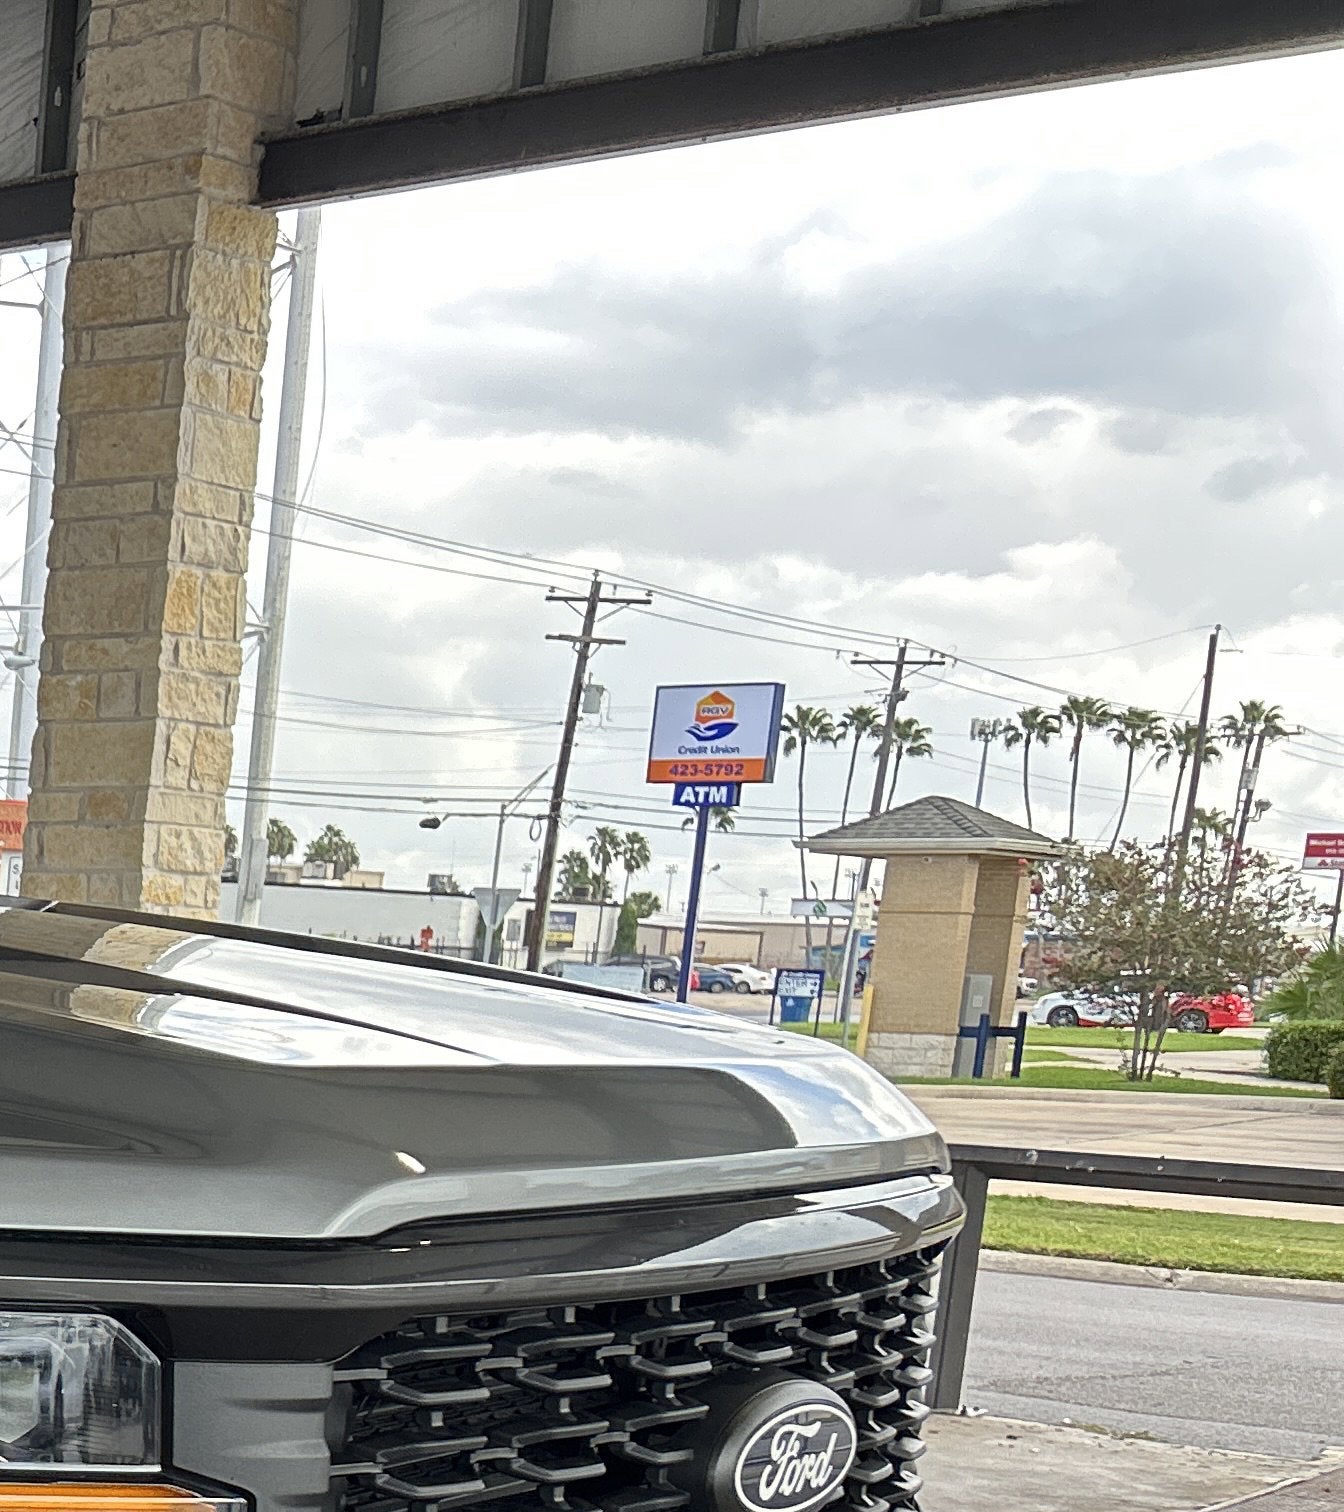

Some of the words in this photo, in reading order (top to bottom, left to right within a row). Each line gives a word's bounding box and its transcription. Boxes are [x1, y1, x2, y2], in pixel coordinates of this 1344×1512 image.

[678, 745, 708, 755] Credit
[711, 745, 740, 755] Union
[669, 763, 744, 776] 423-5792
[679, 786, 728, 803] ATM
[758, 1420, 838, 1501] Ford
